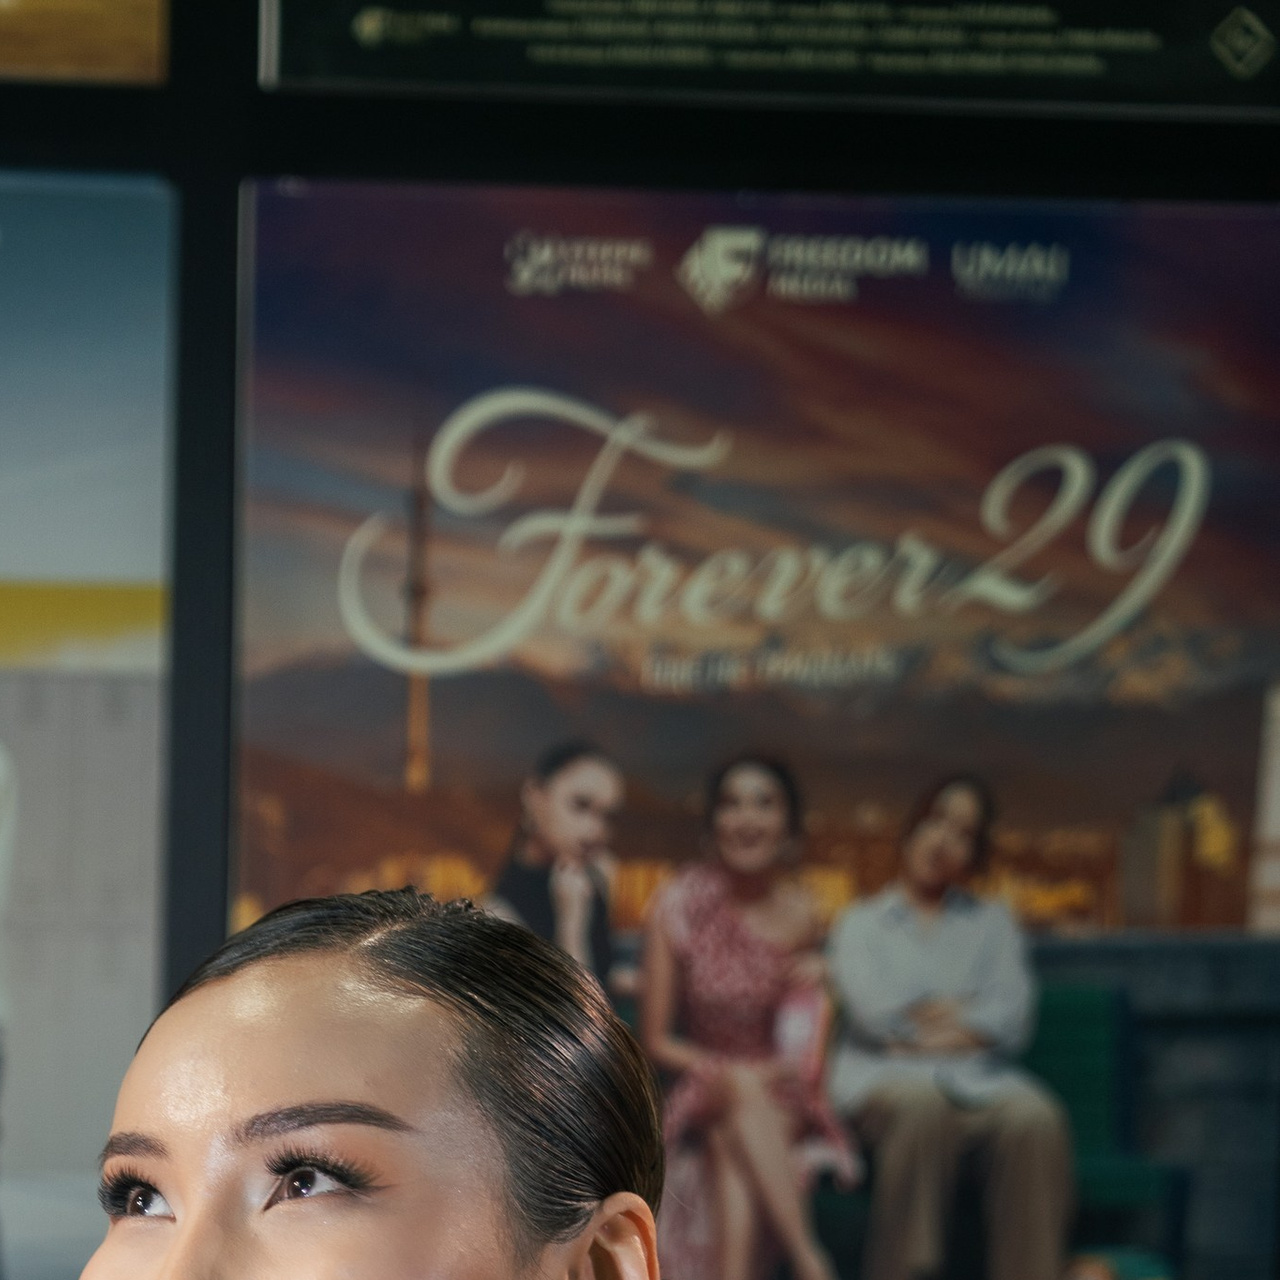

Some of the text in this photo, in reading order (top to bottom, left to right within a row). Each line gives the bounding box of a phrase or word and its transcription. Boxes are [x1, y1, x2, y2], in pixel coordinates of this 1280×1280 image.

[769, 237, 926, 275] FREEDOM
[338, 387, 1210, 675] Forever 29
